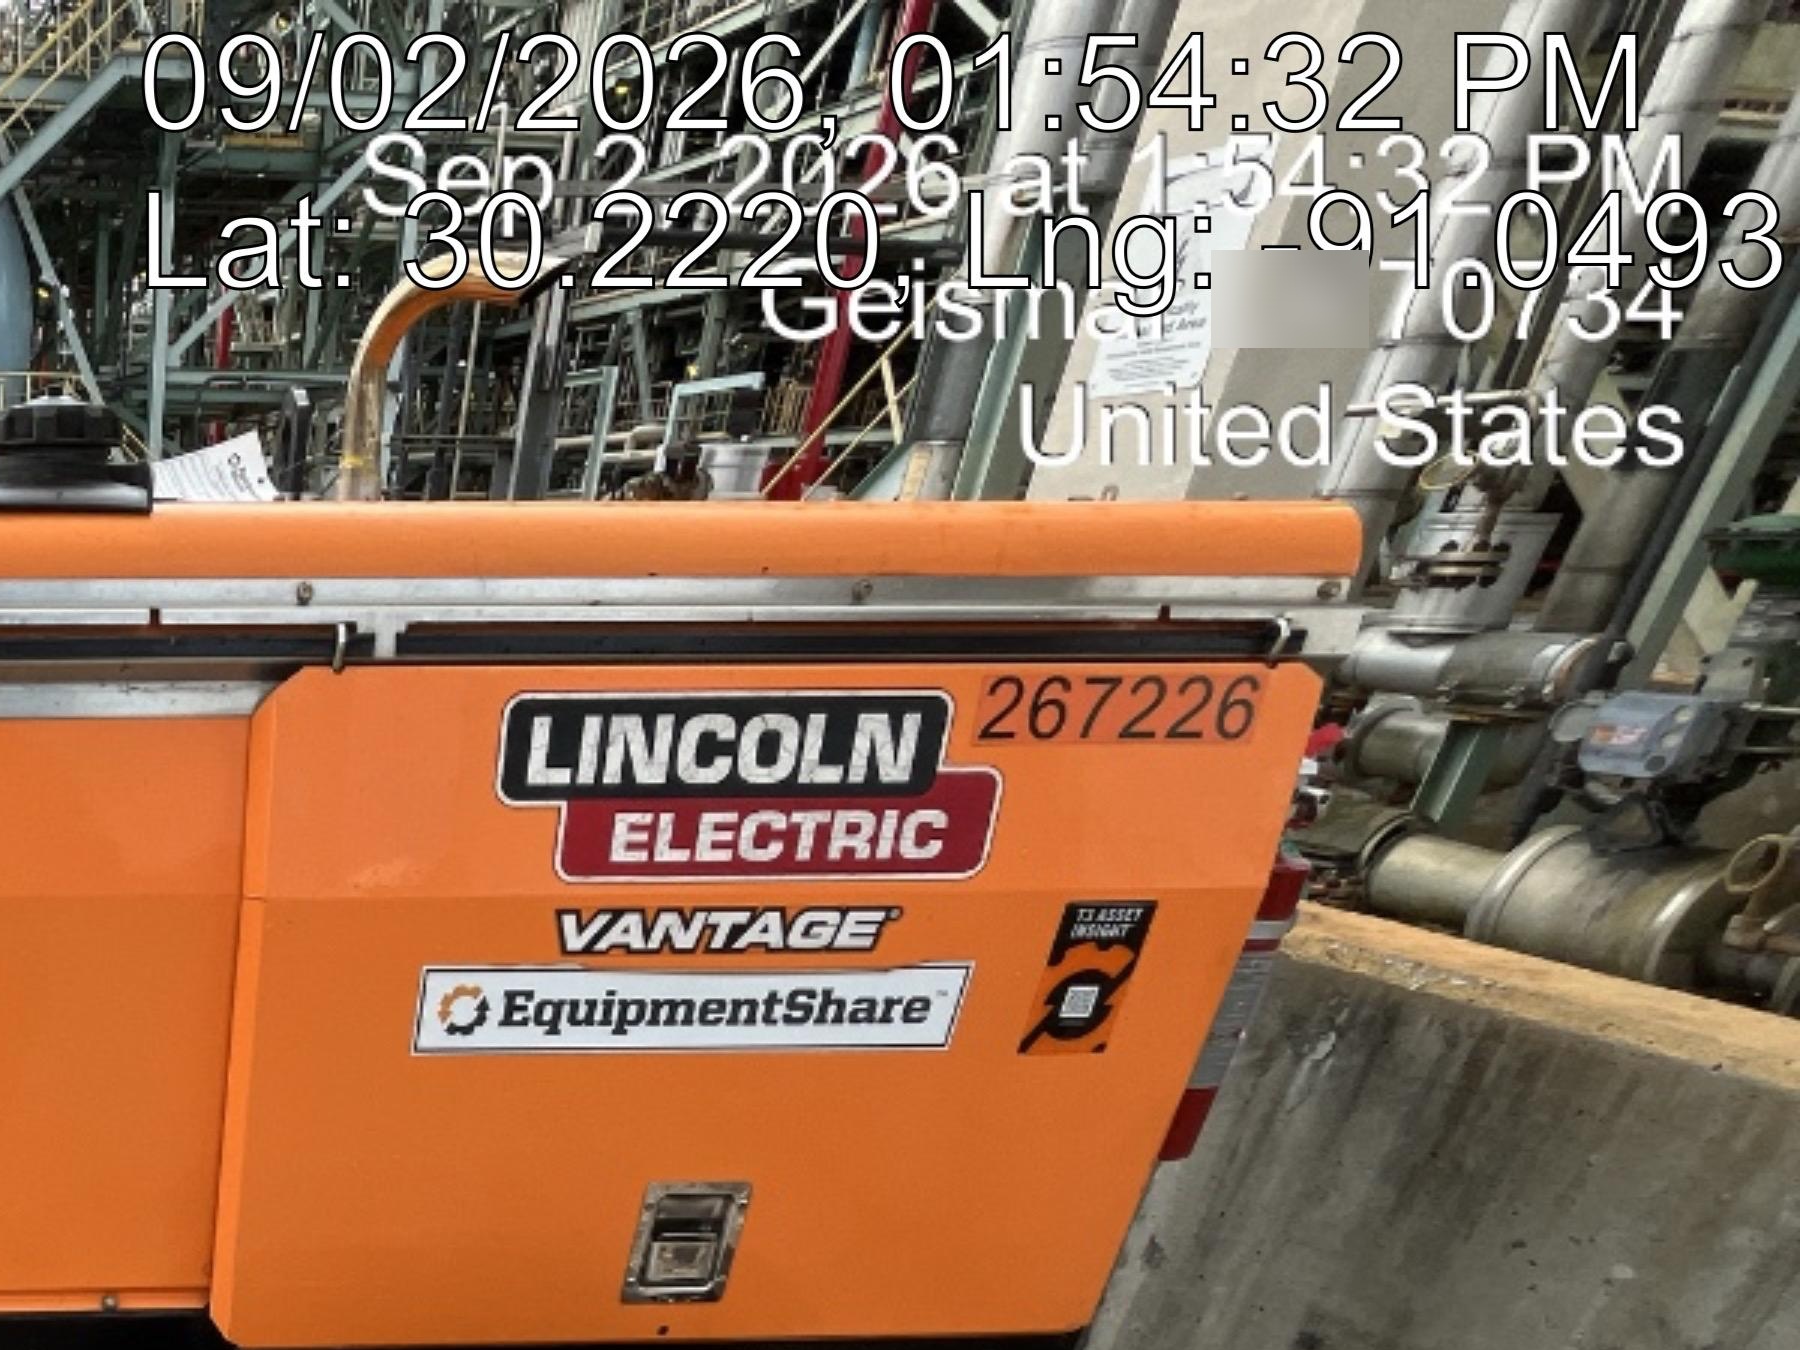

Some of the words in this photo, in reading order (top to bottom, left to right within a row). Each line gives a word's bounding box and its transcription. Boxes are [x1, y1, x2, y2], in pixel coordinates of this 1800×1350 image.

[977, 674, 1261, 740] 267226
[526, 712, 923, 788] LINCOLN
[609, 808, 950, 863] ELECTRIC
[560, 908, 890, 954] VANTAGE
[1069, 923, 1131, 938] INSIGHT
[1096, 908, 1144, 921] ASSET
[497, 987, 933, 1035] EquipmentShare
